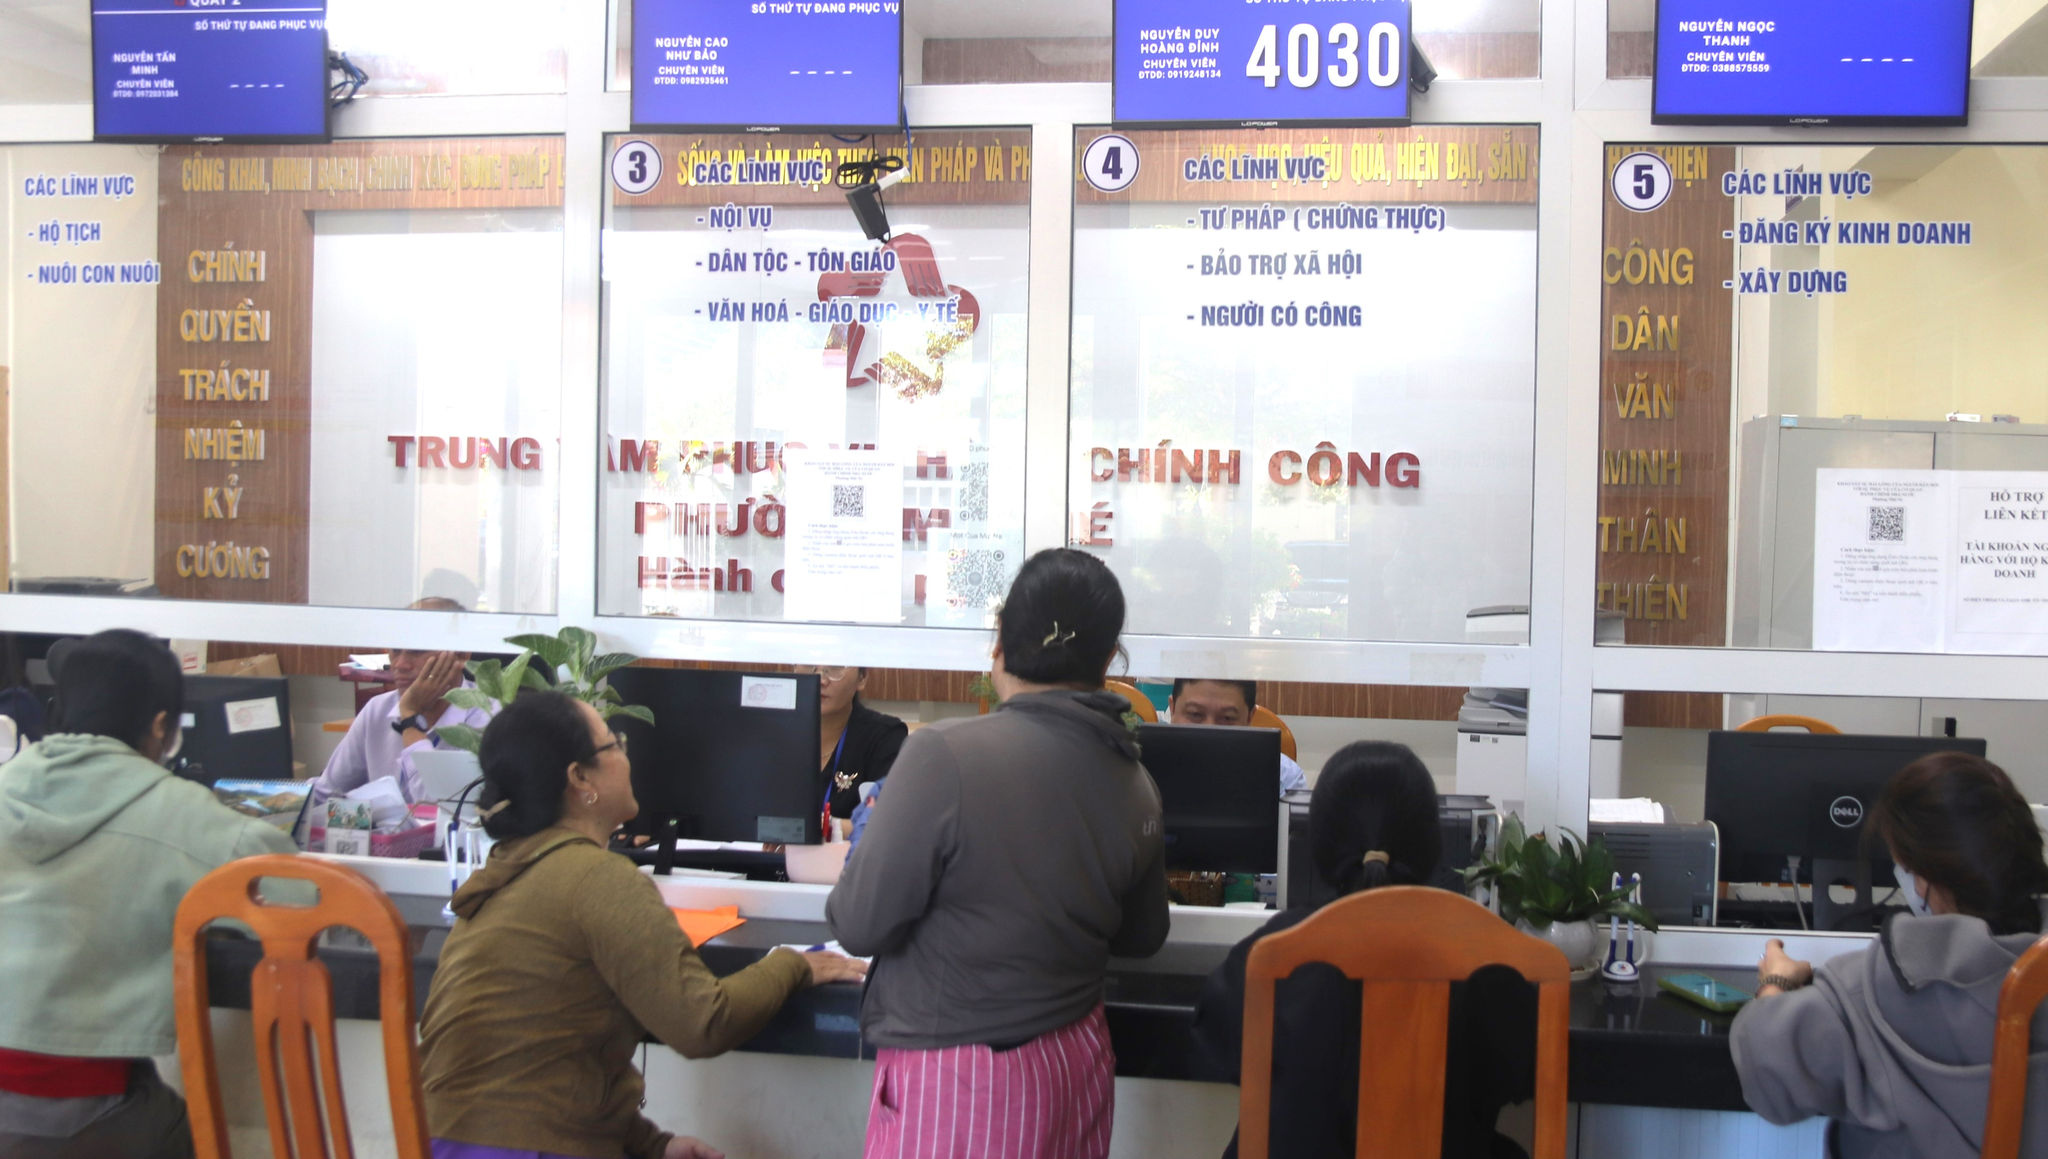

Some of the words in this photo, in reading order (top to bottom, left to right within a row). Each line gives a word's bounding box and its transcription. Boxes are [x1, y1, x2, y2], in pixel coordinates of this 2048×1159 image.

[752, 1, 766, 14] SỐ
[770, 2, 793, 13] THỨ
[796, 2, 812, 15] TỰ
[814, 3, 846, 13] ĐANG
[850, 2, 880, 14] PHỤC
[884, 2, 899, 14] VỤ
[194, 19, 209, 30] SỐ
[211, 19, 231, 30] THỨ
[234, 20, 247, 32] TỰ
[250, 20, 276, 30] ĐANG
[280, 20, 306, 30] PHỤC
[1194, 28, 1220, 39] DUY
[1702, 35, 1750, 46] THANH
[1738, 21, 1775, 34] NGỌC
[666, 50, 692, 60] NHƯ
[704, 37, 728, 48] CAO
[1140, 41, 1184, 54] HOÀNG
[1246, 22, 1401, 88] 4030
[1686, 50, 1734, 62] CHUYÊN
[1738, 50, 1765, 62] VIÊN
[132, 65, 158, 74] MINH
[658, 64, 698, 74] CHUYÊN
[702, 64, 725, 74] VIÊN
[1143, 57, 1188, 68] CHUYÊN
[1190, 56, 1216, 68] VIÊN
[182, 151, 224, 192] CÔNG
[272, 156, 312, 192] MINH
[508, 146, 550, 190] PHÁP
[628, 150, 648, 184] 3
[695, 157, 732, 183] CÁC
[738, 158, 780, 183] LĨNH
[786, 159, 824, 186] VỰC
[930, 140, 978, 183] PHÁP
[984, 138, 1004, 182] VÀ
[1102, 146, 1124, 180] 4
[1184, 153, 1225, 180] CÁC
[1232, 154, 1278, 180] LĨNH
[1286, 156, 1326, 184] VỰC
[1397, 134, 1440, 188] HIỆN
[25, 174, 56, 196] CÁC
[61, 174, 98, 196] LĨNH
[104, 175, 134, 199] VỰC
[1633, 164, 1655, 200] 5
[1722, 168, 1766, 195] CÁC
[1773, 168, 1822, 195] LĨNH
[1830, 170, 1872, 200] VỰC
[710, 202, 742, 232] NỘI
[748, 206, 772, 232] VỤ
[1200, 206, 1228, 230] TƯ
[1232, 204, 1287, 230] PHÁP
[1307, 204, 1378, 230] CHỨNG
[1738, 218, 1798, 244] ĐĂNG
[1805, 216, 1832, 244] KÝ
[1838, 222, 1890, 244] KINH
[1899, 222, 1971, 244] DOANH
[39, 220, 60, 246] HỘ
[66, 222, 100, 245] TỊCH
[38, 262, 77, 284] NUÔI
[82, 264, 115, 283] CON
[120, 261, 160, 283] NUÔI
[188, 241, 266, 283] CHÍNH
[708, 248, 746, 272] DÂN
[753, 248, 788, 276] TỘC
[808, 248, 848, 272] TÔN
[850, 246, 896, 272] GIÁO
[1200, 248, 1242, 276] BẢO
[1248, 252, 1288, 280] TRỢ
[1293, 249, 1321, 276] XÃ
[1327, 248, 1362, 280] HỘI
[1602, 238, 1694, 286] CÔNG
[1739, 267, 1780, 294] XÂY
[1788, 268, 1848, 298] DỰNG
[180, 298, 270, 342] QUYỀN
[708, 298, 748, 322] VĂN
[752, 298, 788, 322] HOÁ
[808, 298, 854, 322] GIÁO
[859, 302, 897, 327] DỤC
[918, 303, 929, 321] Y
[936, 296, 958, 323] TẾ
[1200, 301, 1264, 328] NGƯỜI
[1270, 302, 1298, 328] CÓ
[1304, 300, 1362, 328] CÔNG
[1612, 304, 1679, 352] DÂN
[178, 360, 270, 402] TRÁCH
[1614, 372, 1676, 420] VĂN
[184, 420, 266, 468] NHIỆM
[388, 436, 542, 470] TRUNG
[1090, 439, 1240, 484] CHÍNH
[1268, 440, 1421, 488] CÔNG
[1602, 448, 1683, 486] MINH
[203, 474, 243, 520] KỶ
[634, 494, 786, 538] PHƯỜ
[1598, 506, 1687, 554] THÂN
[176, 540, 270, 580] CƯƠNG
[638, 556, 752, 592] Hành
[1994, 569, 2036, 578] DOANH
